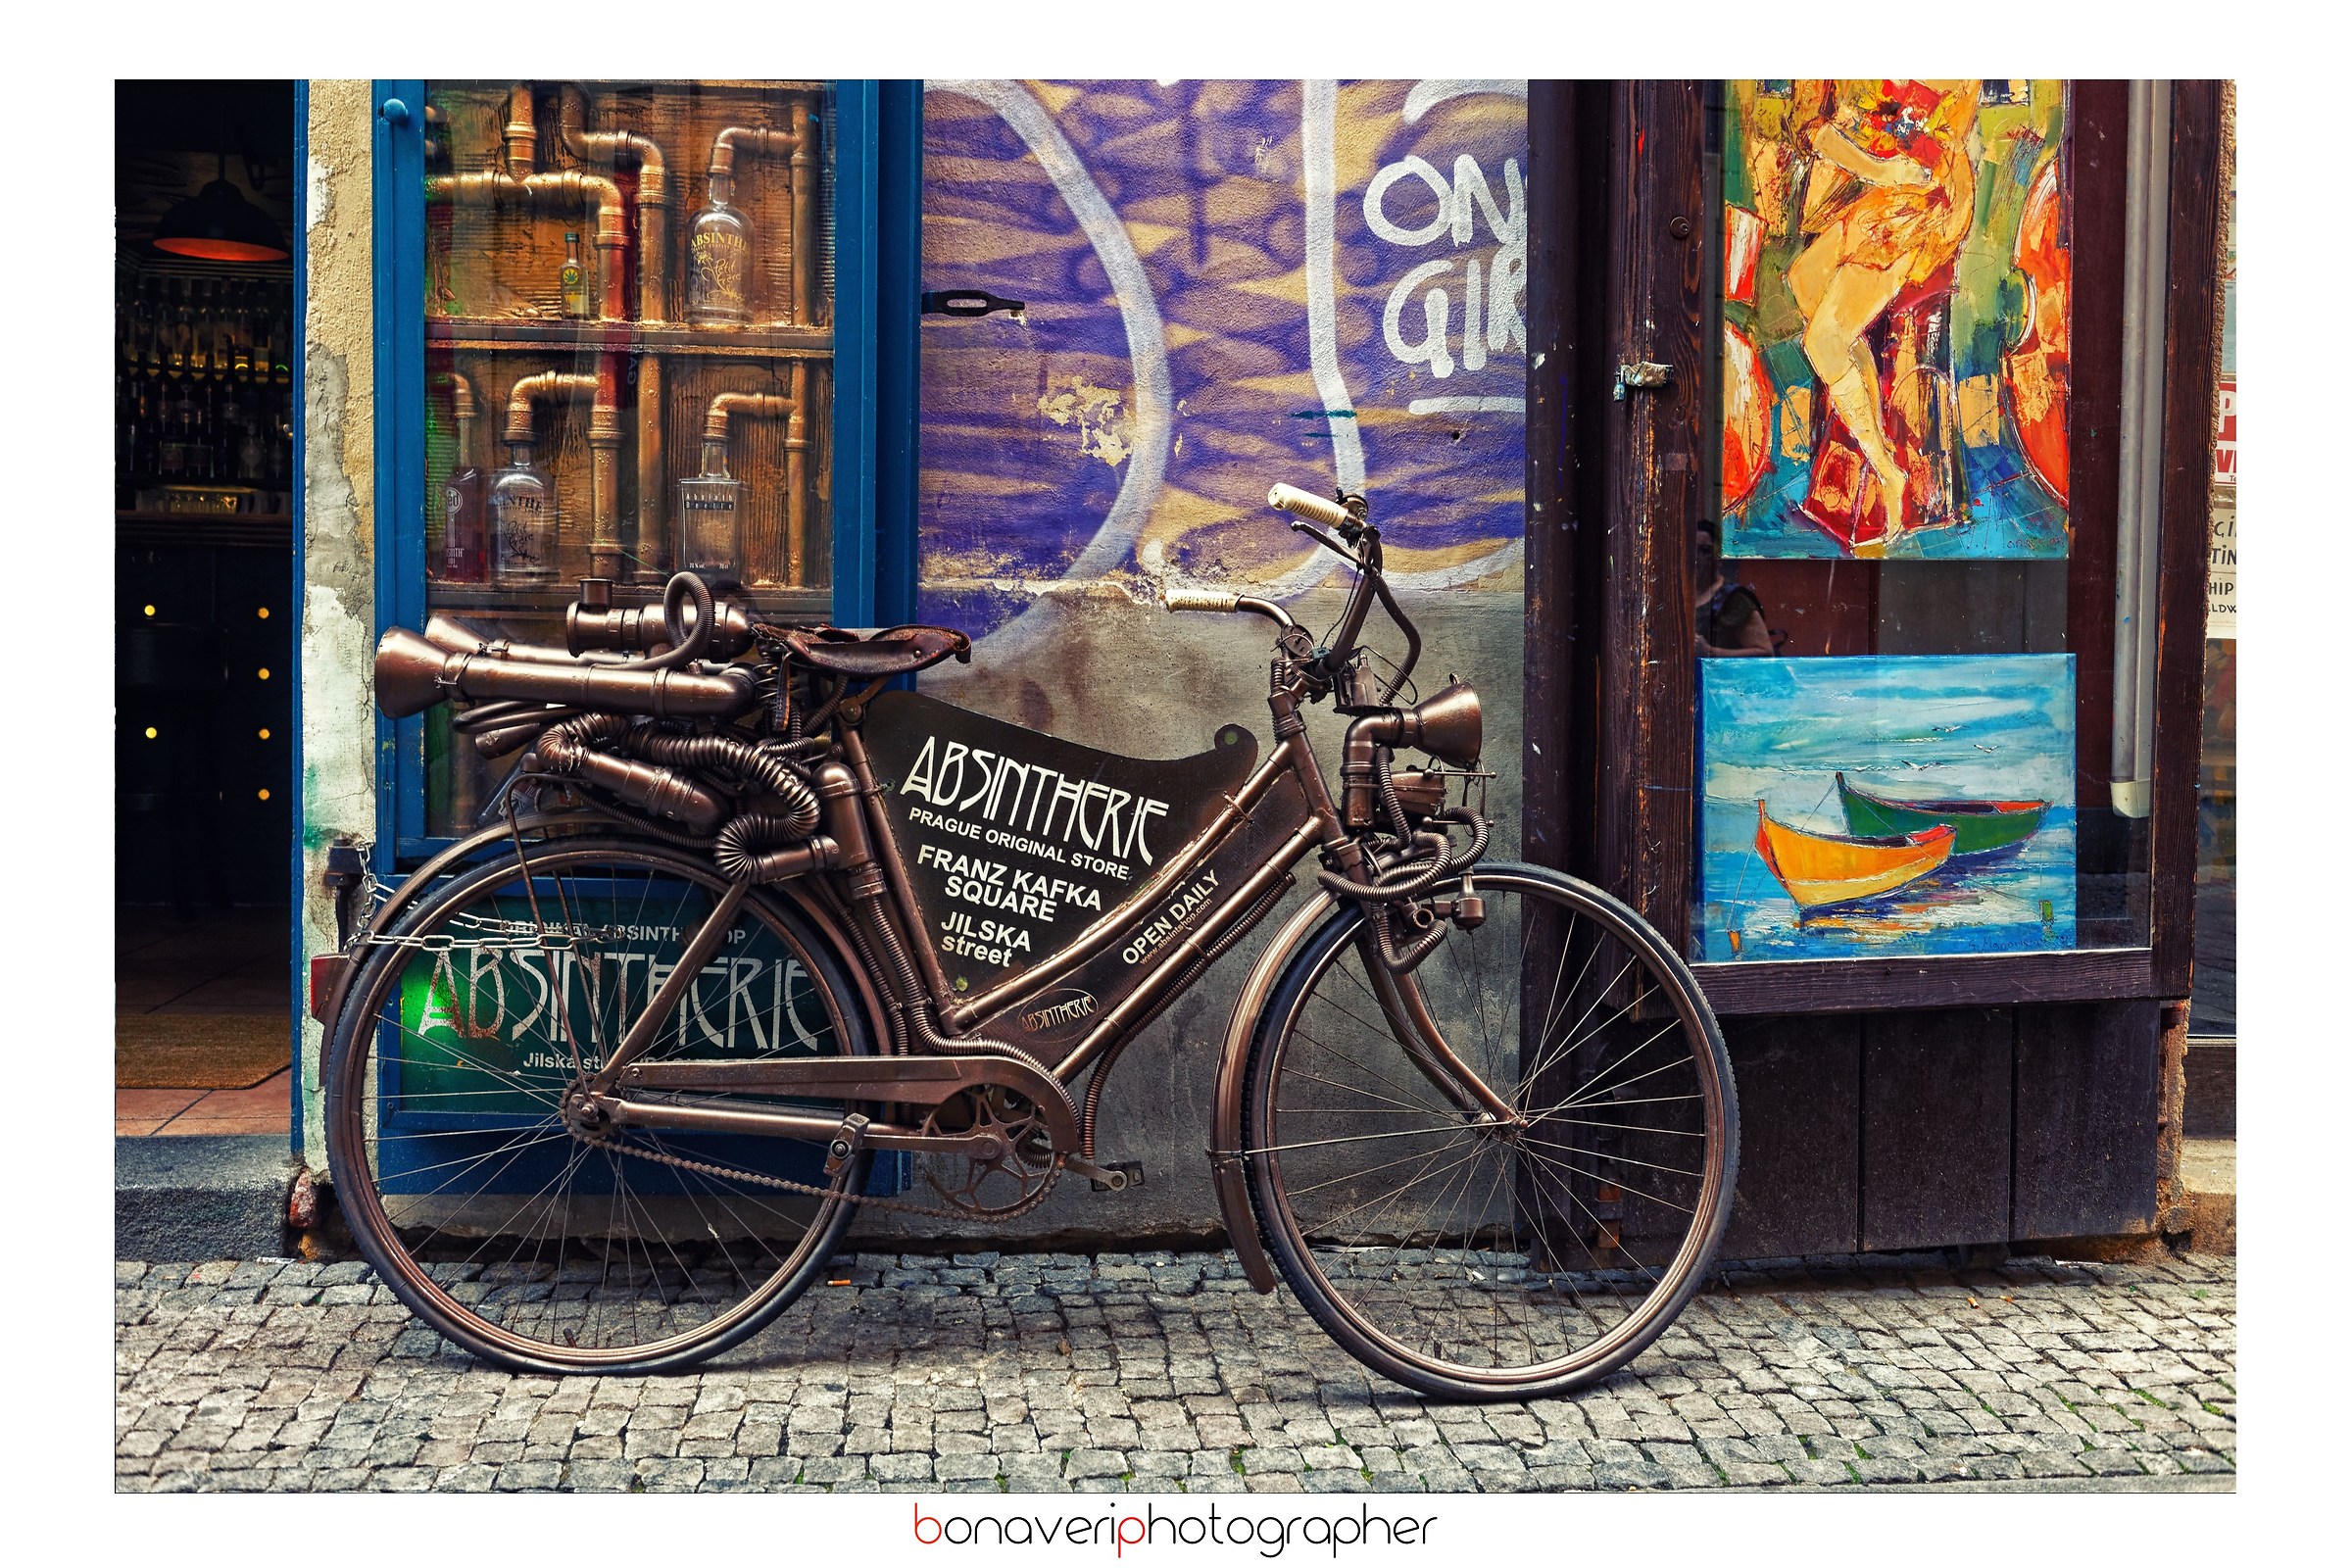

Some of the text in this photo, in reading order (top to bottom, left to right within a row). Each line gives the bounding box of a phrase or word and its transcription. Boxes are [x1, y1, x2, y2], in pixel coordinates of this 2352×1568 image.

[1363, 154, 1527, 247] ON
[899, 735, 1170, 866] ABSINTHERIE
[908, 808, 1130, 881] PRAGUE ORIGINAL STORE
[917, 845, 1102, 911] FRANZ KAFKA
[944, 876, 1058, 922] SQUARE
[941, 911, 1032, 953] JILSKA
[1122, 868, 1219, 964] OPEN DAILY
[1140, 898, 1212, 965] www.absintshop.com
[941, 935, 1013, 968] street
[1021, 995, 1095, 1033] ABSINTHERIE
